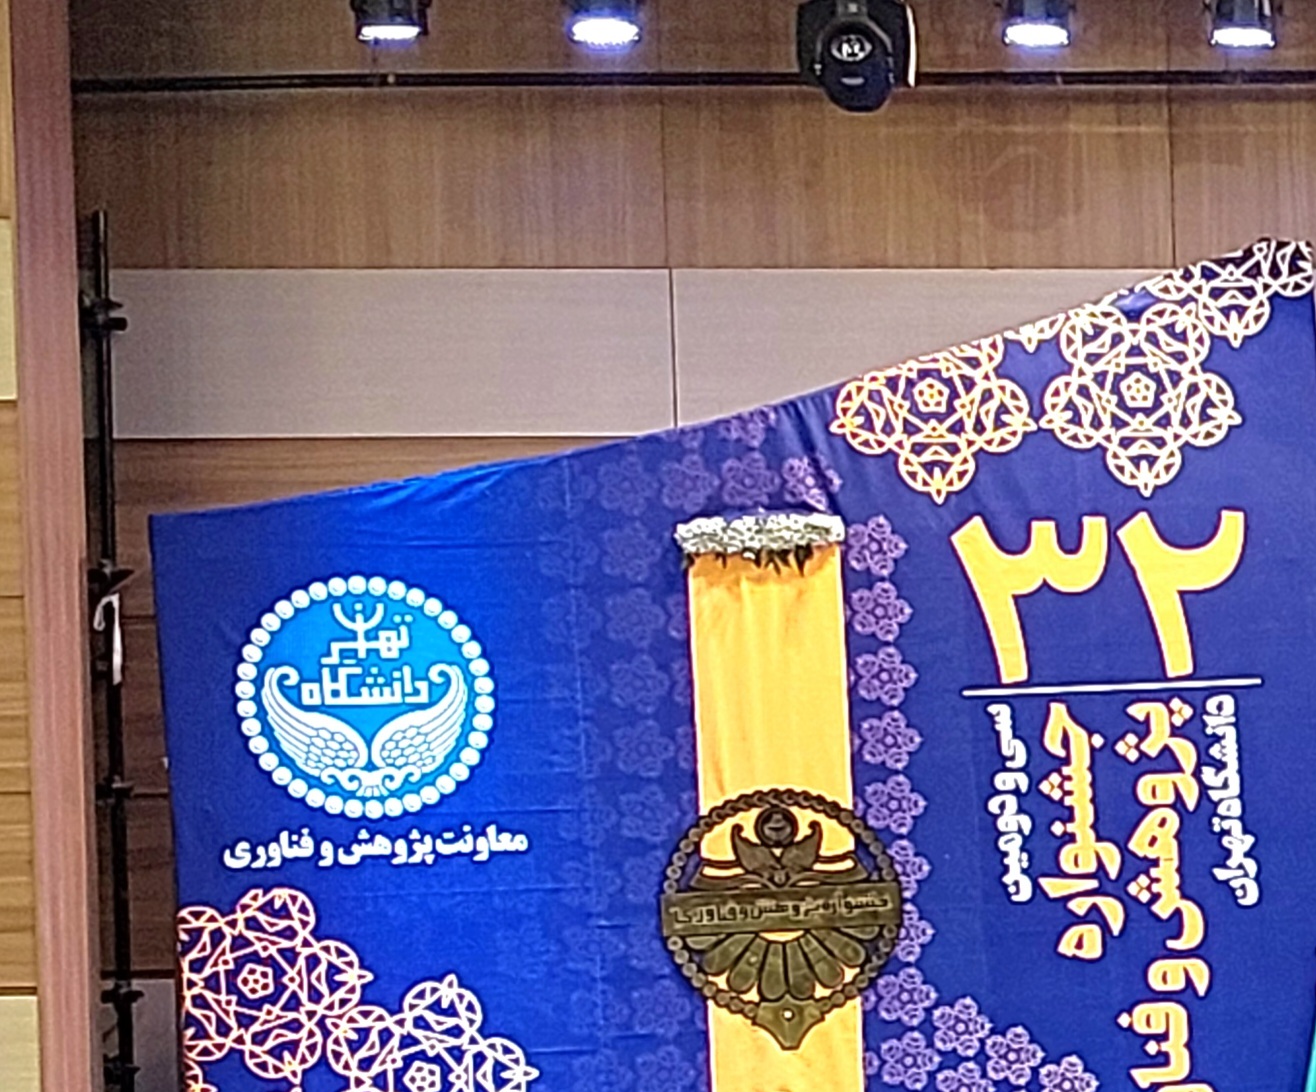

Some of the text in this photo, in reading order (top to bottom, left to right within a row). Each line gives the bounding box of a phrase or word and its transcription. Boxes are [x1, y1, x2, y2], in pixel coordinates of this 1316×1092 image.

[950, 508, 1245, 684] ۳۲
[223, 824, 528, 869] معاونت پژوهش و فناوری
[986, 703, 1032, 902] سی و دومین
[1037, 702, 1126, 960] جشنواره
[1114, 697, 1205, 950] پژوهش
[1201, 694, 1259, 905] دانشگاه تهران
[1147, 957, 1211, 997] و
